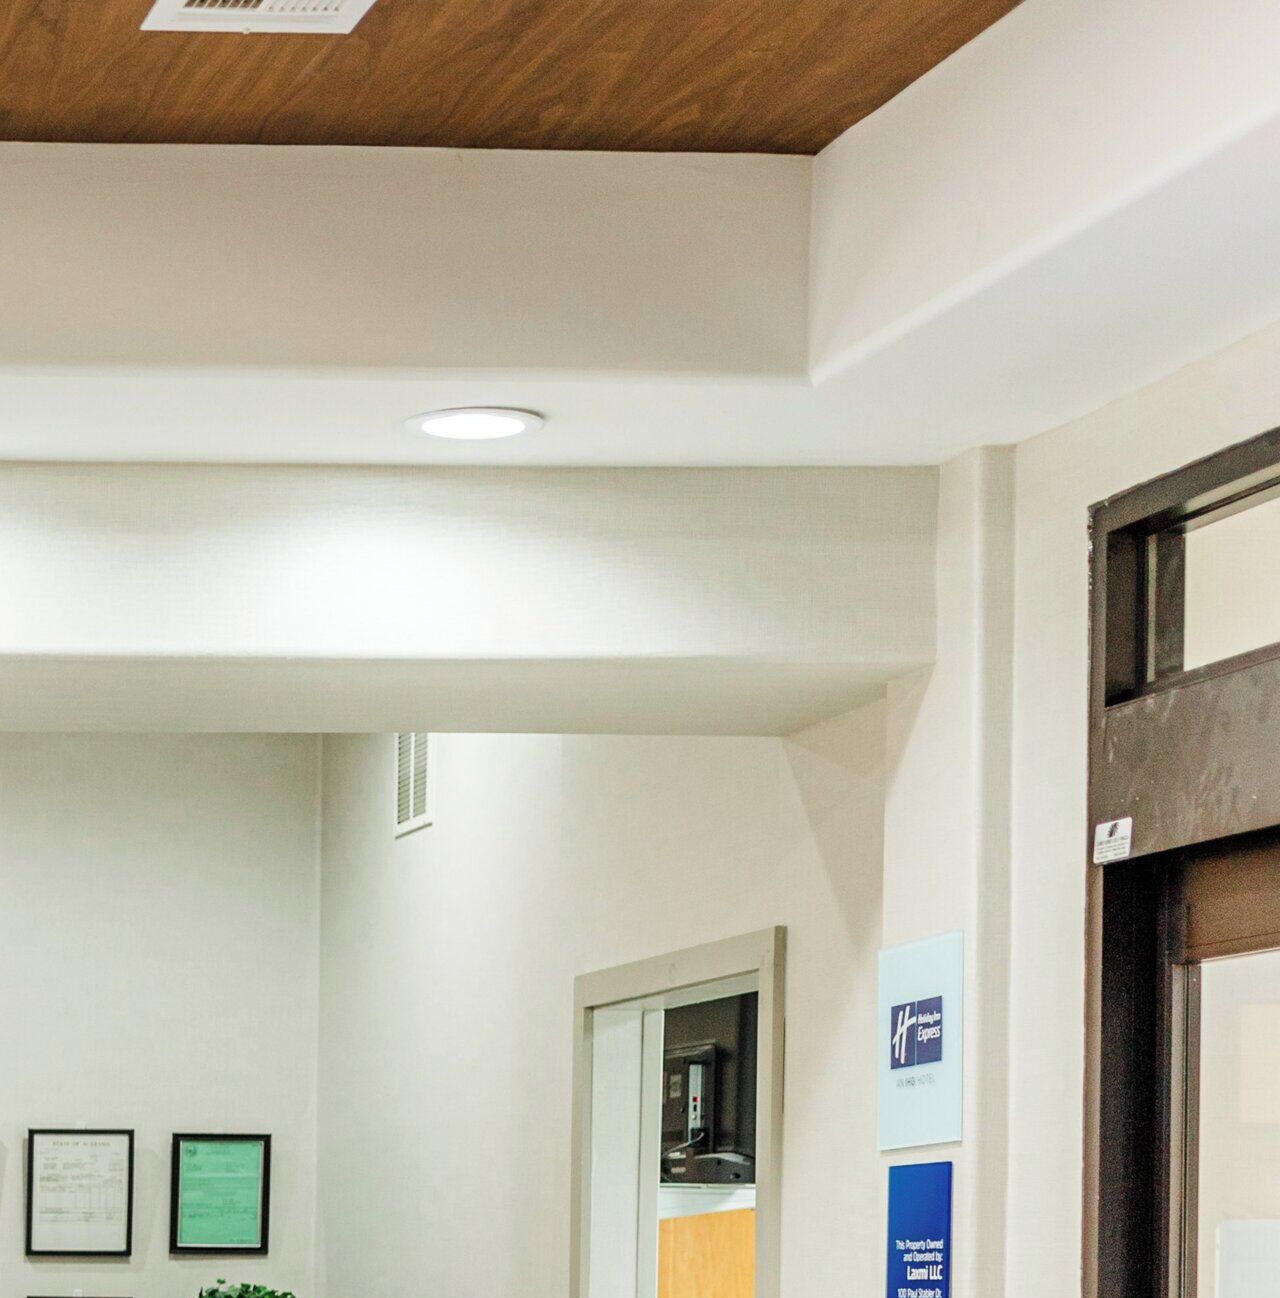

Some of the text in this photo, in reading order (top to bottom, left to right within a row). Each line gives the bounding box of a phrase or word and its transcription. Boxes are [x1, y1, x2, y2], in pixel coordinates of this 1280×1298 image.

[917, 1026, 941, 1044] Express
[895, 1238, 944, 1250] This Property Owned
[903, 1251, 913, 1261] and
[913, 1251, 935, 1262] Operated
[907, 1264, 943, 1281] Laxmi LLC
[907, 1287, 918, 1298] Paul
